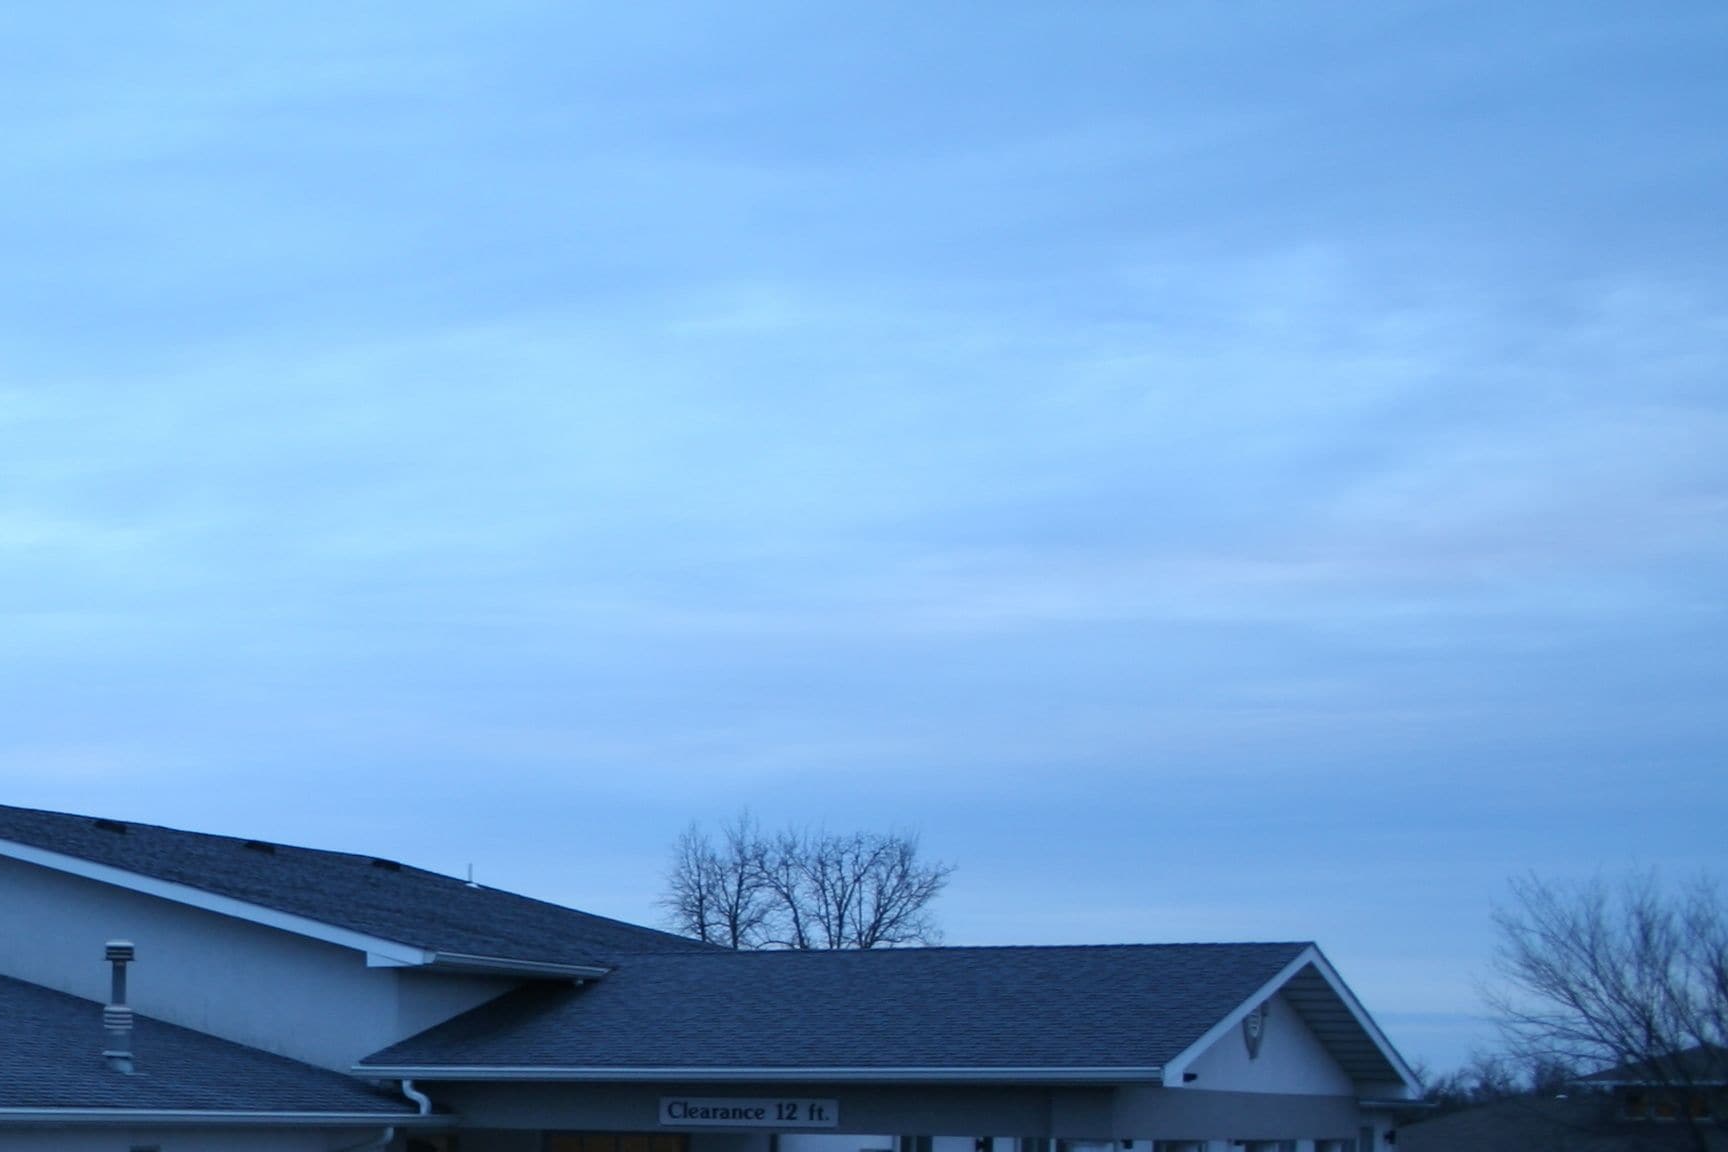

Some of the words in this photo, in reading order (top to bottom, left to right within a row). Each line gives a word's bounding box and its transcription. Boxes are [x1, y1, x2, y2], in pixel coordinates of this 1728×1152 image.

[667, 1101, 766, 1120] Clearance
[775, 1103, 798, 1121] 12
[808, 1102, 830, 1121] ft.
